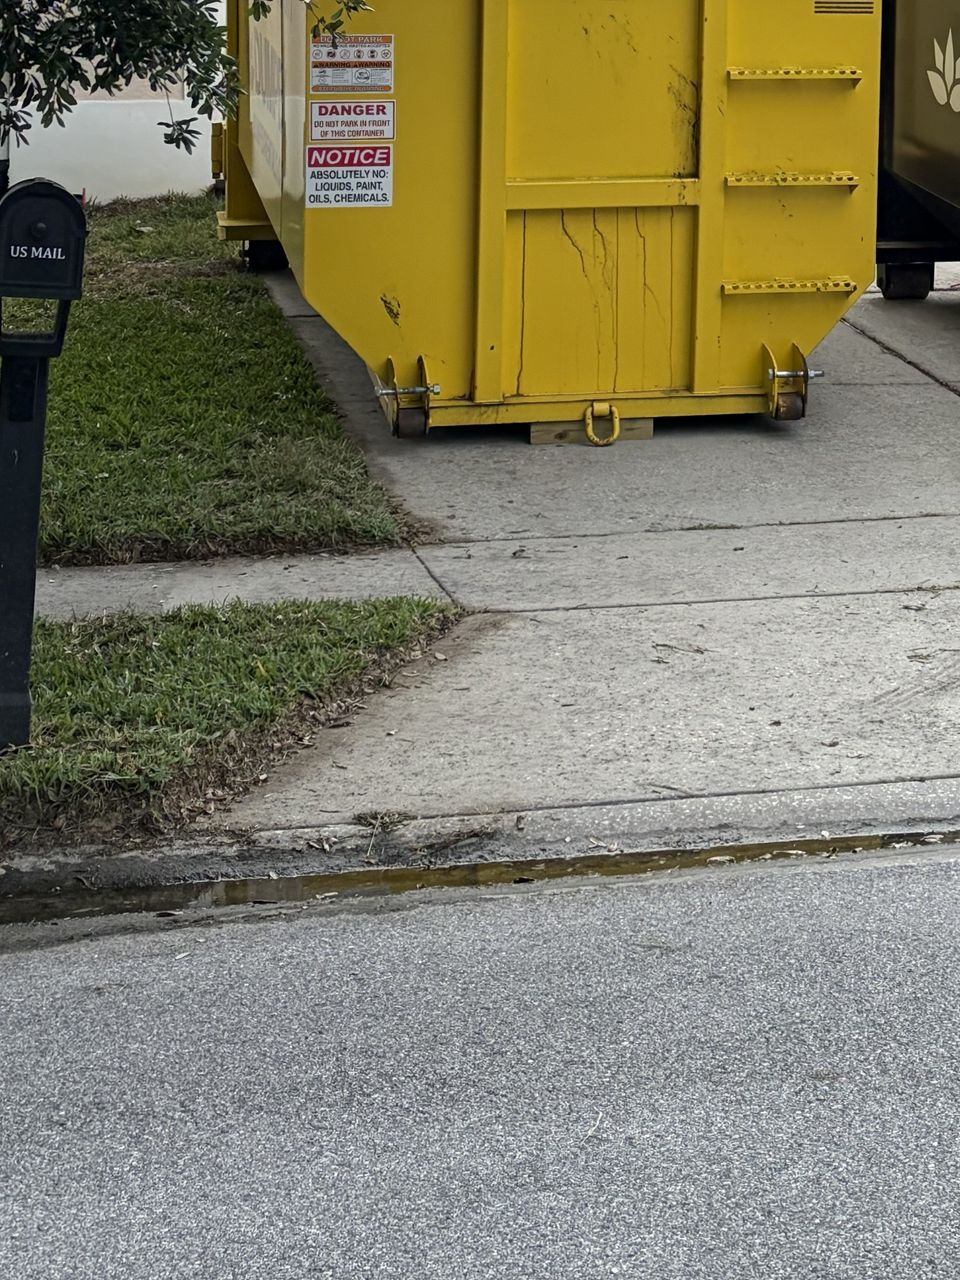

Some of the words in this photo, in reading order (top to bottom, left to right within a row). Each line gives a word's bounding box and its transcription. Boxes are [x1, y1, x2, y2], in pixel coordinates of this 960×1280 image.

[358, 35, 383, 43] PARK
[318, 104, 387, 116] DANGER
[314, 120, 324, 128] DO
[325, 120, 339, 128] NOT
[368, 119, 391, 127] FRONT
[310, 149, 389, 165] NOTICE
[310, 169, 371, 179] ABSOLUTELY
[372, 169, 389, 179] NO:
[315, 181, 354, 192] LIQUIDS,
[356, 181, 384, 191] PAINT,
[308, 194, 332, 204] OILS,
[334, 193, 390, 203] CHEMICALS.
[10, 245, 28, 258] US
[31, 246, 66, 260] MAIL
